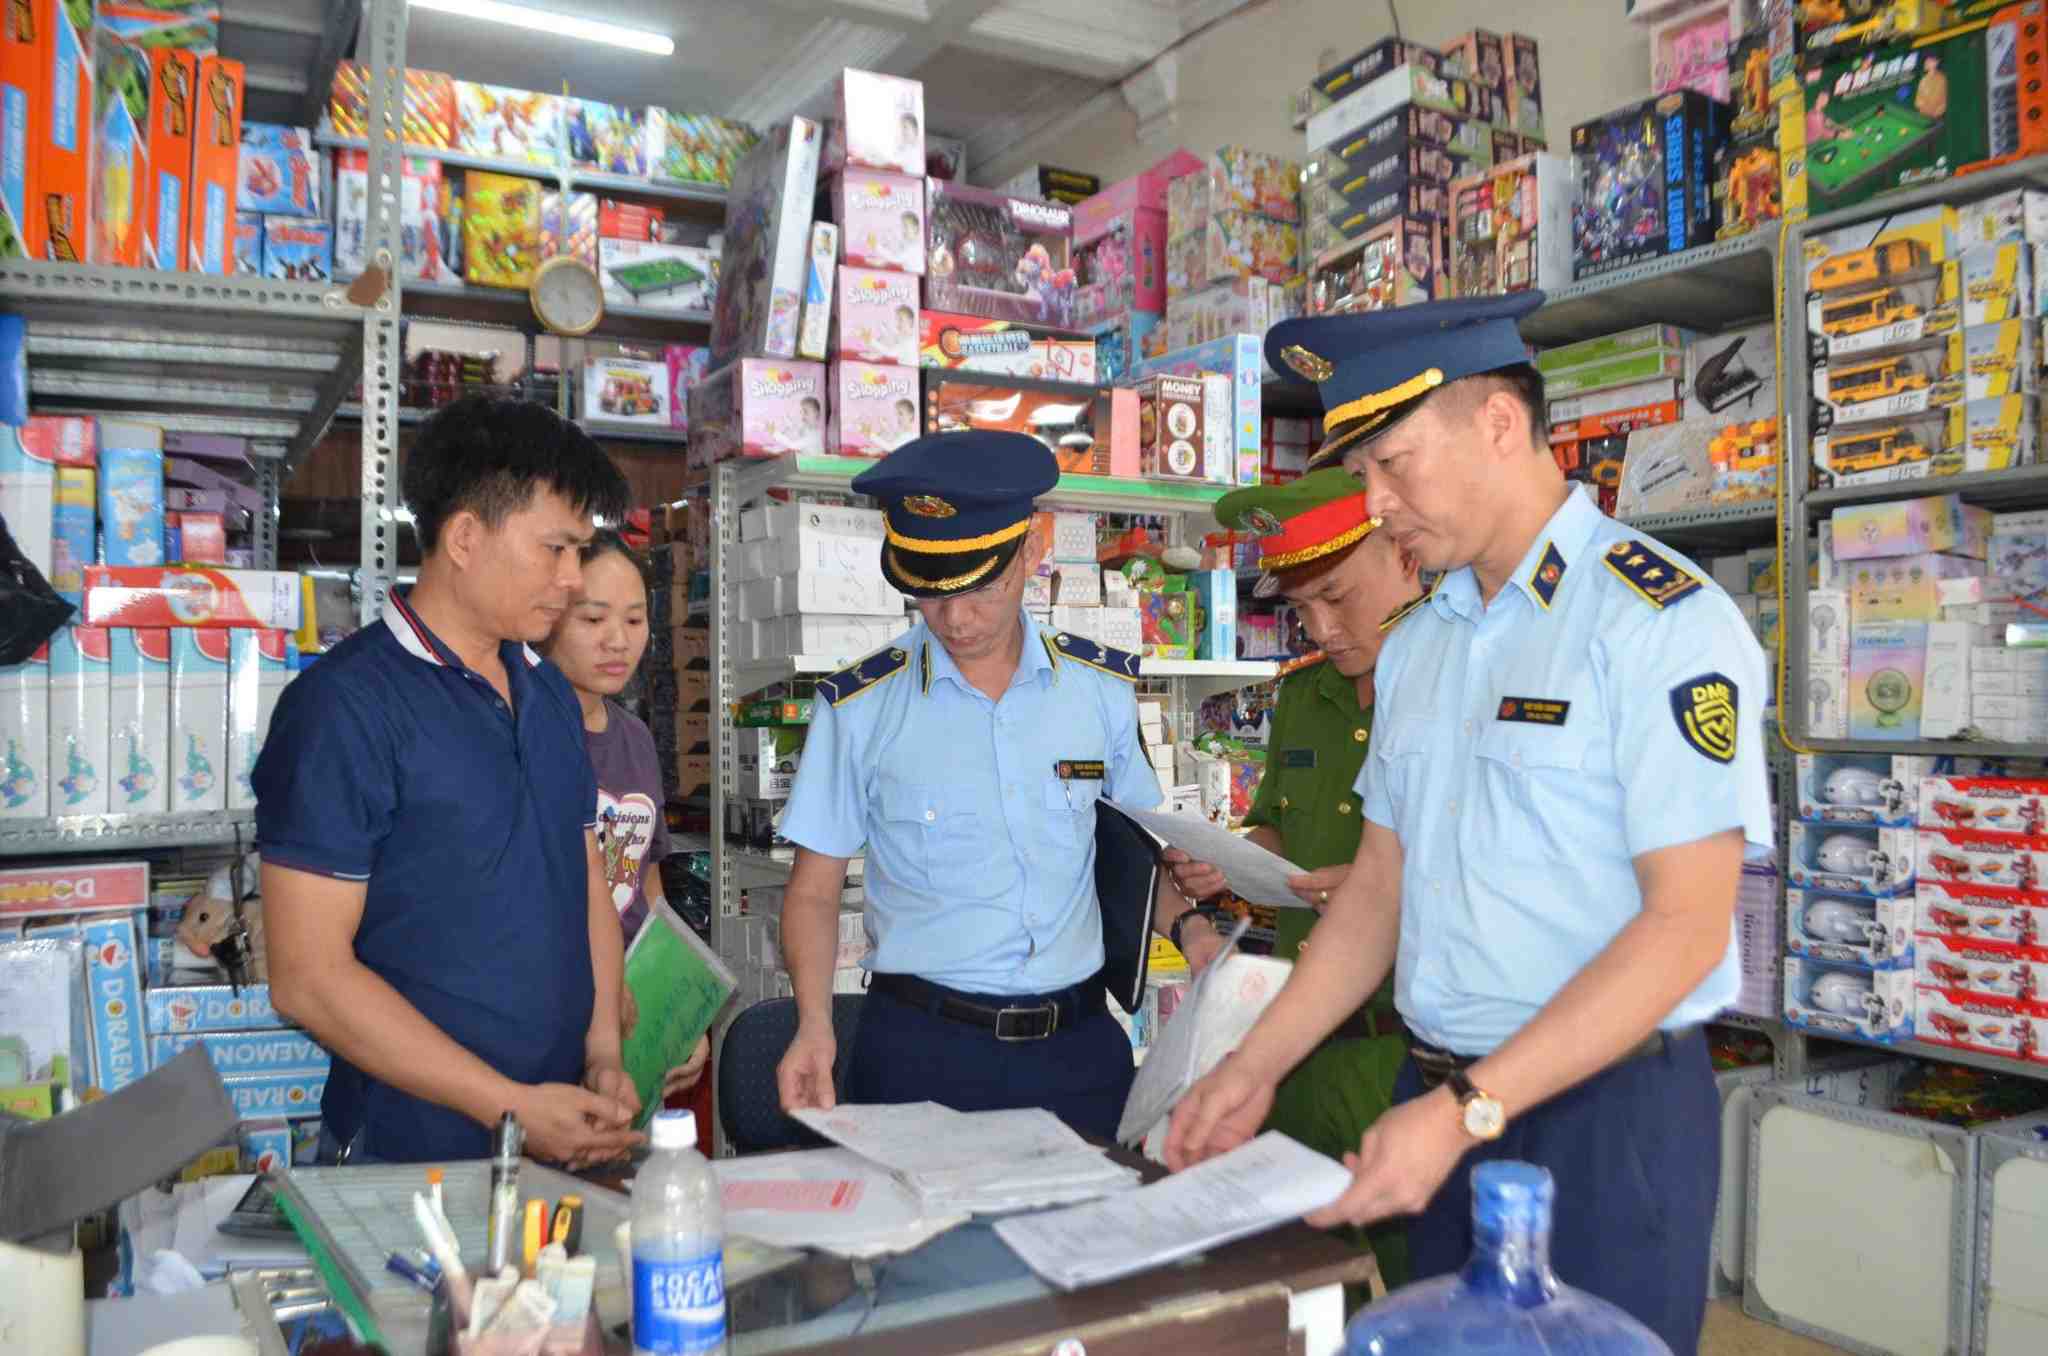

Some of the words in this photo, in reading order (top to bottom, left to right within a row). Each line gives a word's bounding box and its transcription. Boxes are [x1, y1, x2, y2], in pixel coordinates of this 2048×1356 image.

[1012, 200, 1071, 225] DINOSAUR
[1161, 379, 1202, 396] MONEY
[232, 1082, 325, 1109] DORAE
